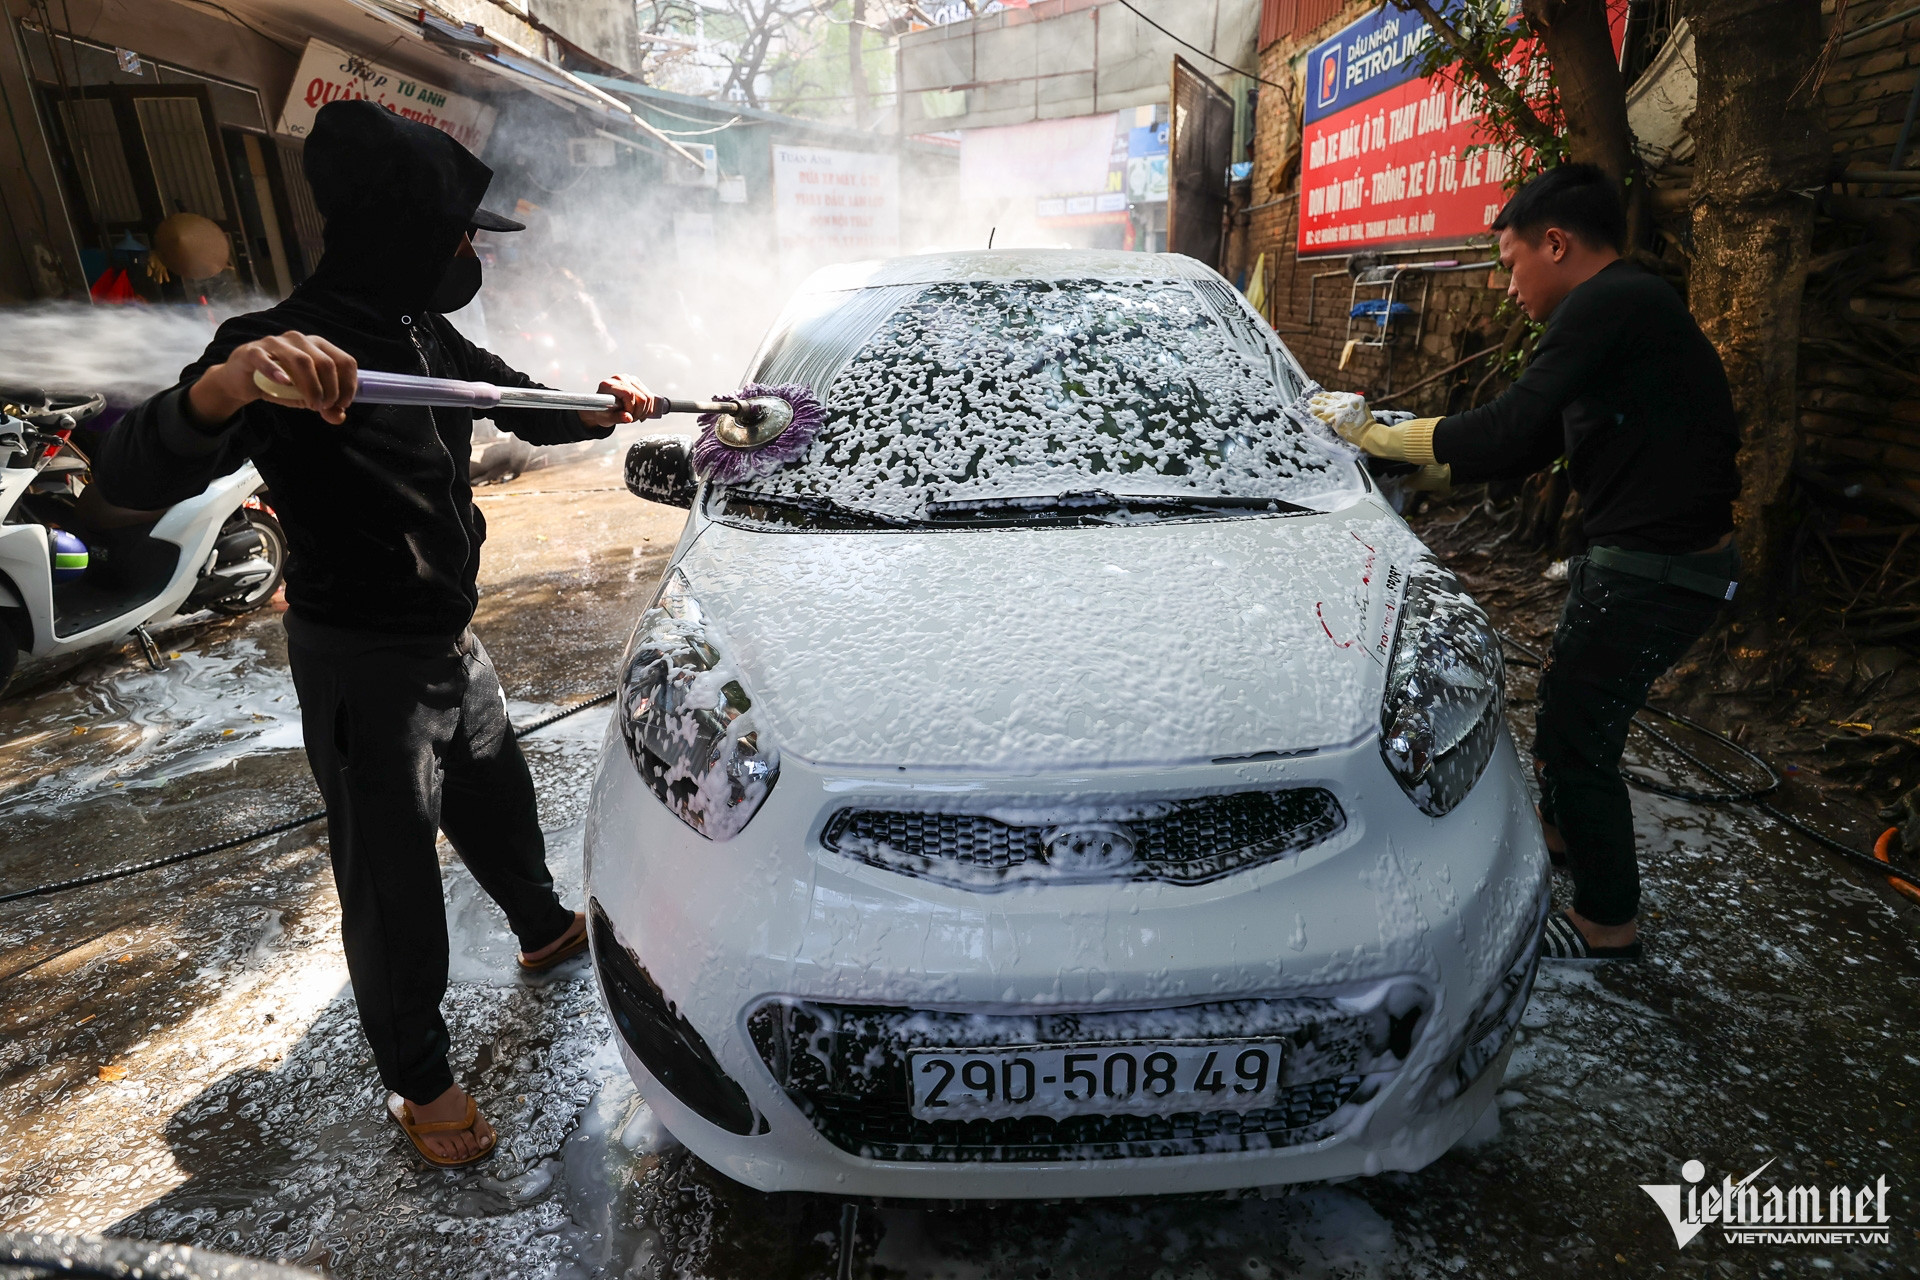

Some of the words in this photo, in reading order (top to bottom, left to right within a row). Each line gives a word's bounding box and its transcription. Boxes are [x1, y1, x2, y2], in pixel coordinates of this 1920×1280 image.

[1345, 14, 1446, 90] PETROLIME
[397, 80, 417, 97] TÚ
[417, 89, 447, 108] ANH
[1326, 132, 1339, 165] XE
[1361, 113, 1371, 154] Ô
[1389, 101, 1418, 145] THAY
[1341, 166, 1365, 211] THẤT
[1371, 162, 1407, 206] TRÔNG
[1406, 160, 1425, 199] XE
[1426, 149, 1437, 195] Ô
[1461, 145, 1483, 189] XE
[1420, 210, 1436, 236] NỘI
